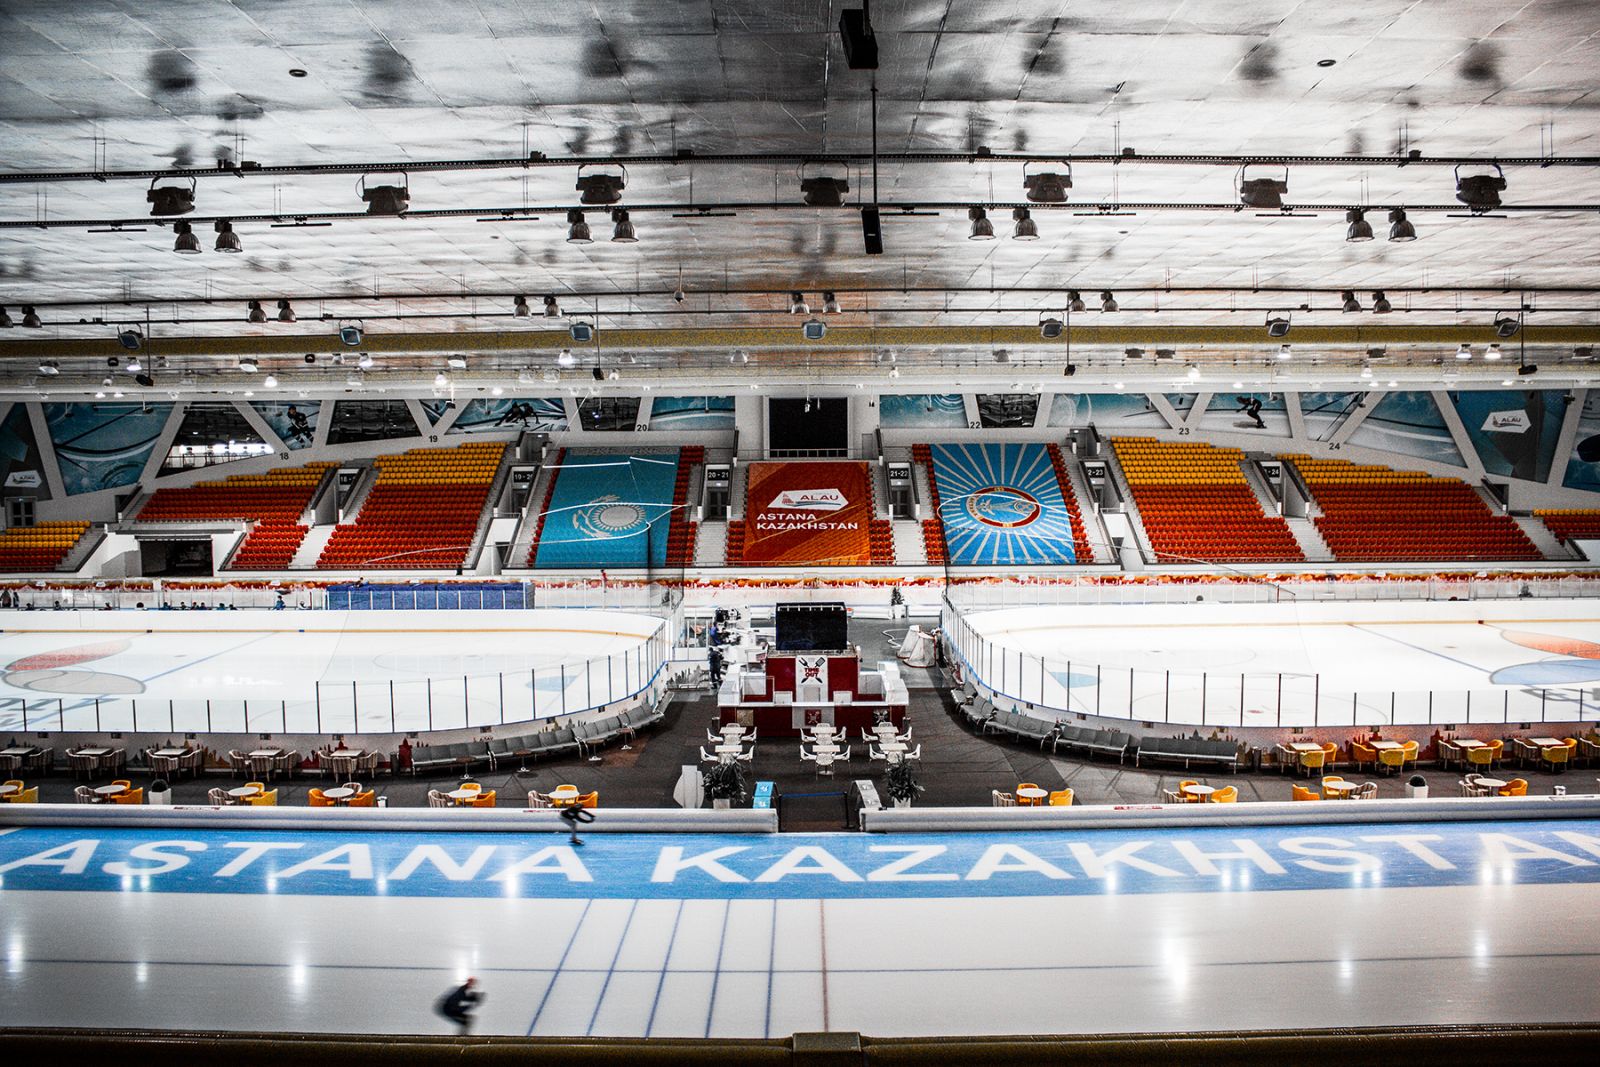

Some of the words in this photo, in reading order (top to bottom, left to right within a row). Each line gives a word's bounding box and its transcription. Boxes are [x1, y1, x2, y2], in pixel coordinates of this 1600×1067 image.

[636, 424, 647, 432] 20
[970, 421, 981, 429] 22
[1178, 427, 1190, 435] 23
[428, 435, 438, 443] 19
[1328, 442, 1340, 450] 24
[279, 452, 289, 460] 18
[756, 522, 858, 530] KAZAKHSTAN
[0, 839, 594, 882] ASTANA
